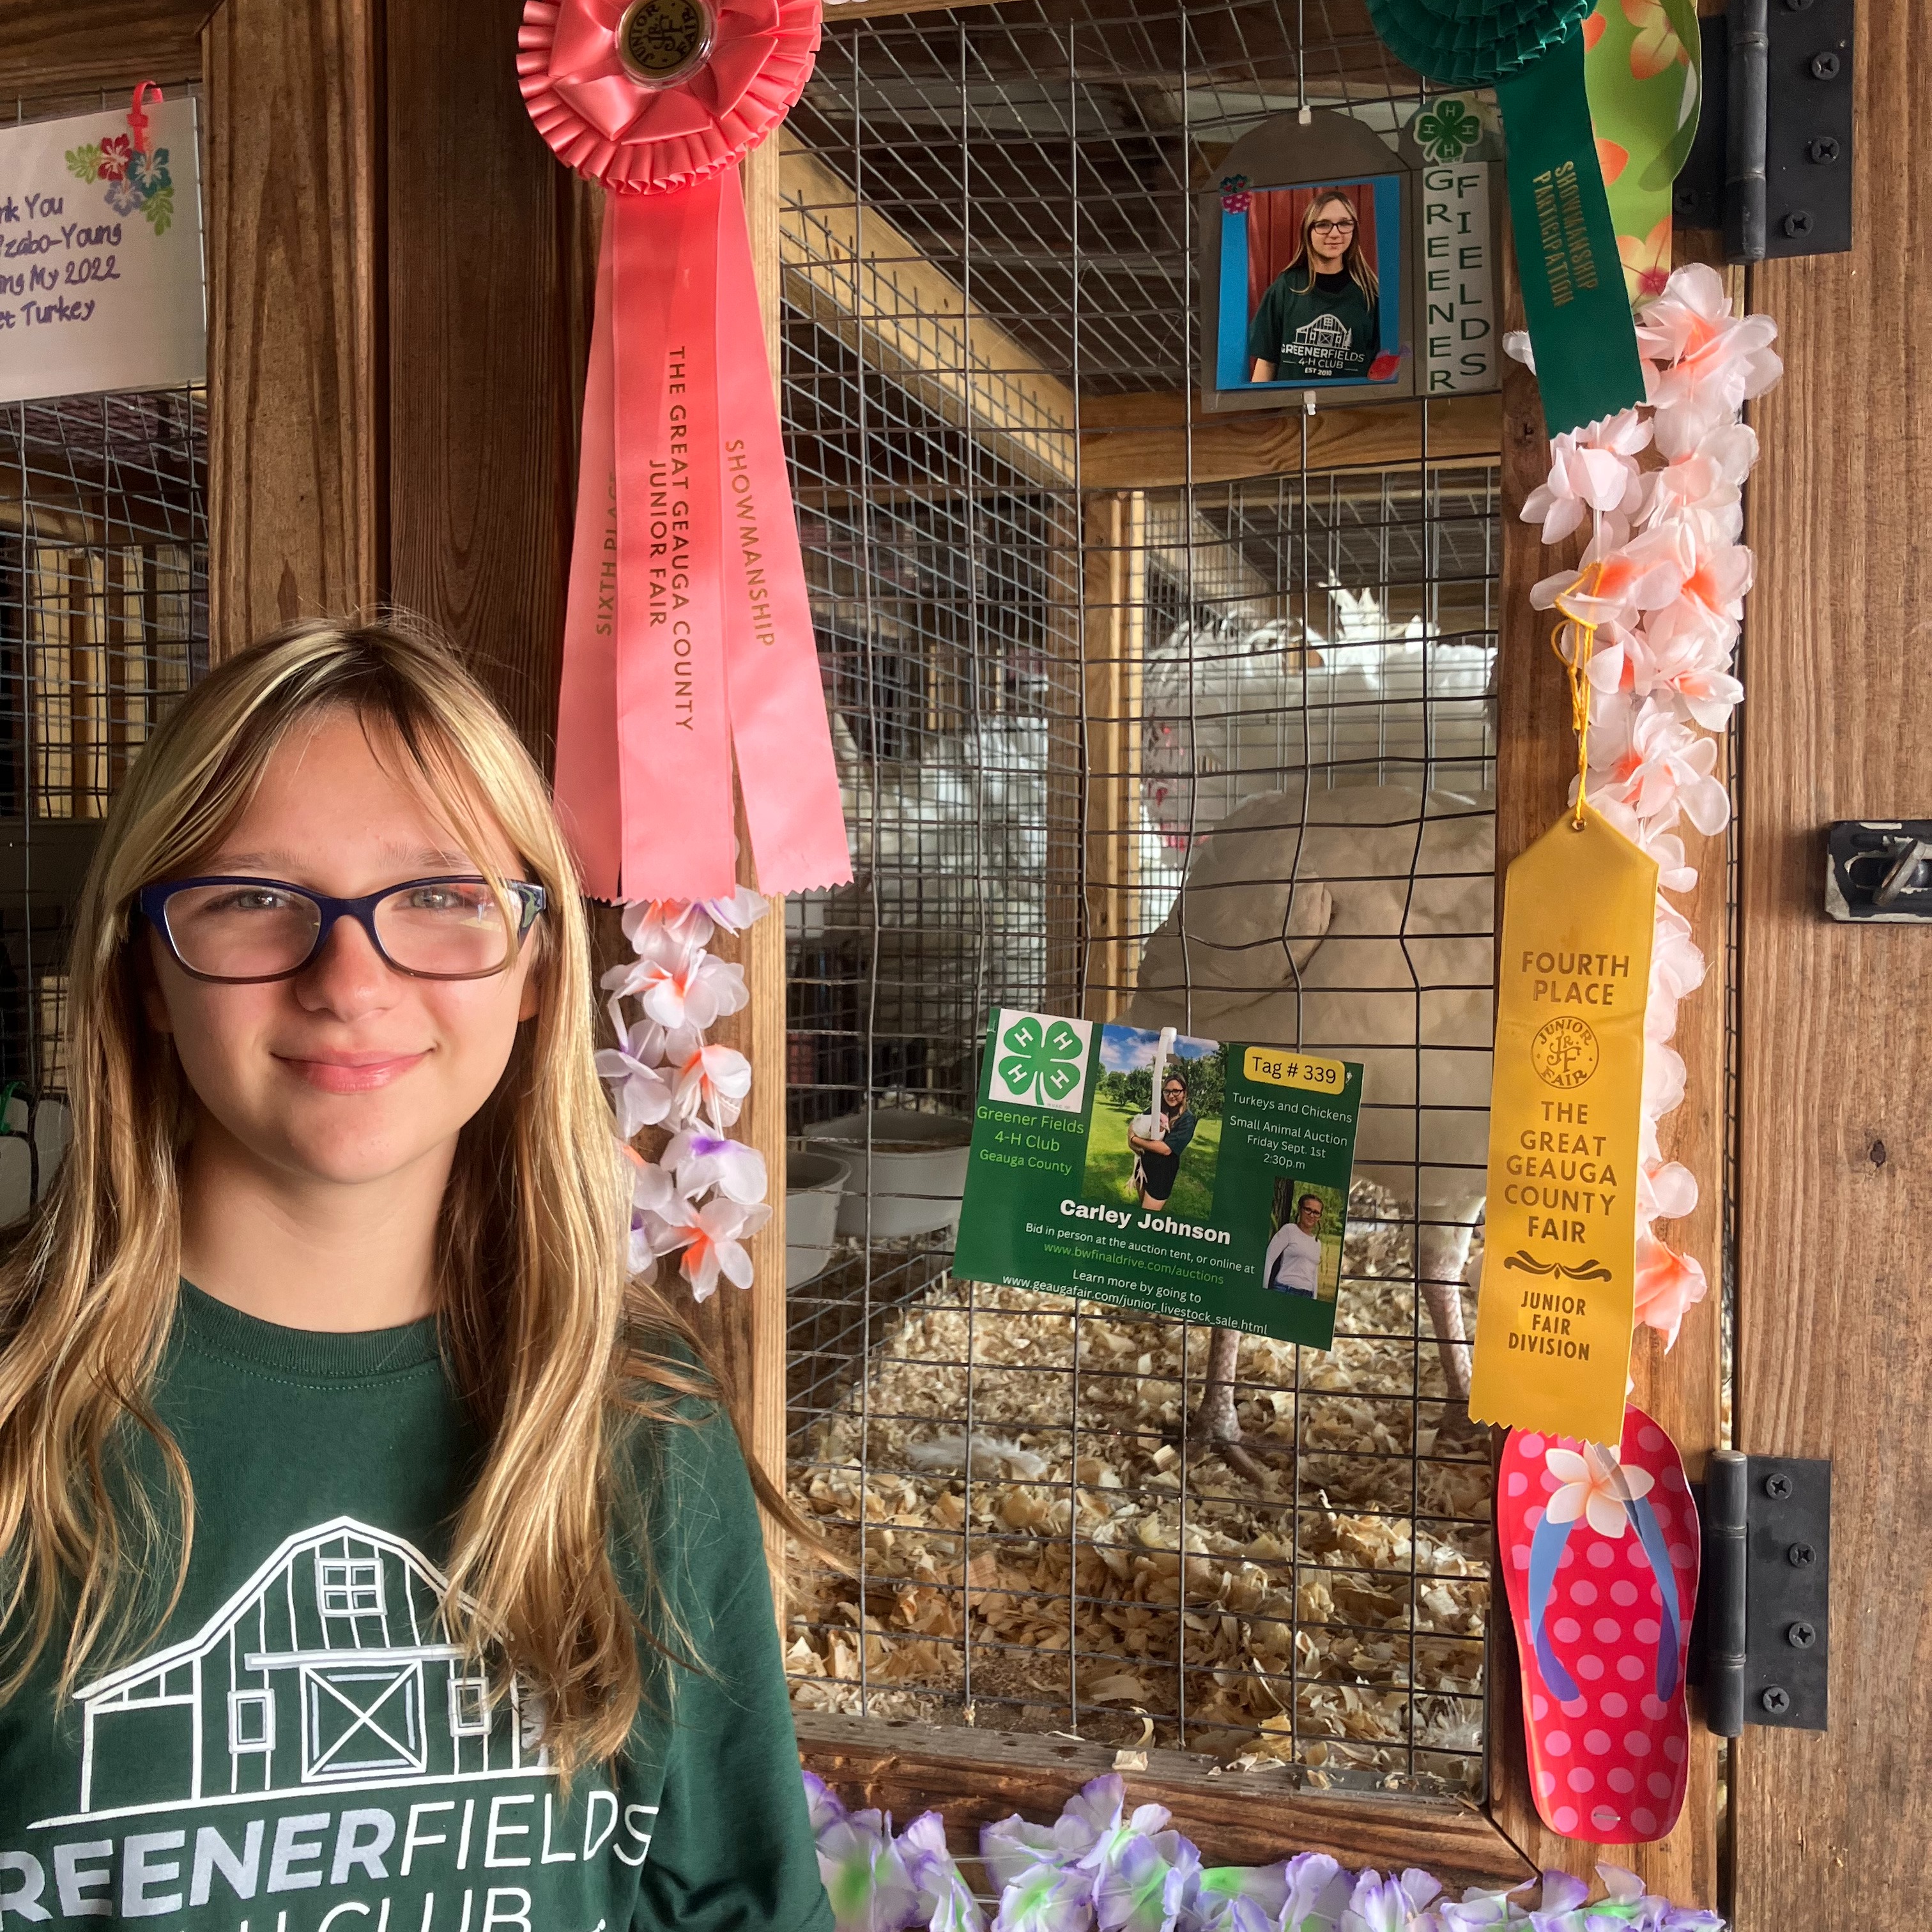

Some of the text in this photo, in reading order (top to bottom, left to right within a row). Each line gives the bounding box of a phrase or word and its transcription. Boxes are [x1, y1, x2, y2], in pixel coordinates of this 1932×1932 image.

[631, 4, 661, 63] JUNIOR
[675, 6, 697, 56] FAIR
[24, 193, 63, 219] You
[1533, 171, 1574, 309] PARTICIPATION
[1554, 160, 1598, 290] SHOWMANSHIP
[29, 264, 59, 291] My
[65, 255, 121, 285] 2022
[1424, 169, 1457, 392] GREENER
[1456, 174, 1491, 376] FIELDS
[20, 295, 95, 327] Turkey
[1281, 343, 1365, 362] GREENERFIELDS
[1298, 358, 1343, 369] 4-H CLUB
[649, 459, 667, 627] JUNIOR FAIR
[669, 346, 693, 731] THE GREAT GEAUGA COUNTY
[725, 439, 774, 646] SHOWMANSHIP
[596, 562, 617, 636] SIXTH
[1522, 951, 1629, 977] FOURTH
[1533, 980, 1614, 1006] PLACE
[1538, 1019, 1592, 1046] JUNIOR
[1252, 1056, 1336, 1084] Tag # 339
[1540, 1066, 1587, 1086] FAIR
[977, 1106, 1084, 1134] Greener Fields
[1233, 1092, 1353, 1123] Turkeys and Chickens
[1541, 1101, 1588, 1126] THE
[994, 1130, 1060, 1152] 4-H Club
[1229, 1115, 1347, 1147] Small Animal Auction
[1247, 1135, 1326, 1158] Friday Sept. 1st
[1521, 1130, 1607, 1158] GREAT
[979, 1149, 1072, 1176] Geauga County
[1263, 1153, 1305, 1170] 2:30p.m
[1506, 1154, 1618, 1187] GEAUGA
[1504, 1184, 1616, 1217] COUNTY
[1060, 1199, 1231, 1245] Carley Johnson
[1528, 1215, 1586, 1245] FAIR
[1025, 1222, 1255, 1275] Bid in person at the auction tent, or online at
[1044, 1243, 1224, 1285] www.bwfinaldrive.com/auctions
[1073, 1269, 1202, 1303] Learn more by going to
[1002, 1275, 1268, 1335] www.geaugafair.com/junior_livestock_sale.html
[1521, 1291, 1586, 1317] JUNIOR
[1531, 1314, 1571, 1337] FAIR
[1508, 1332, 1590, 1362] DIVISION
